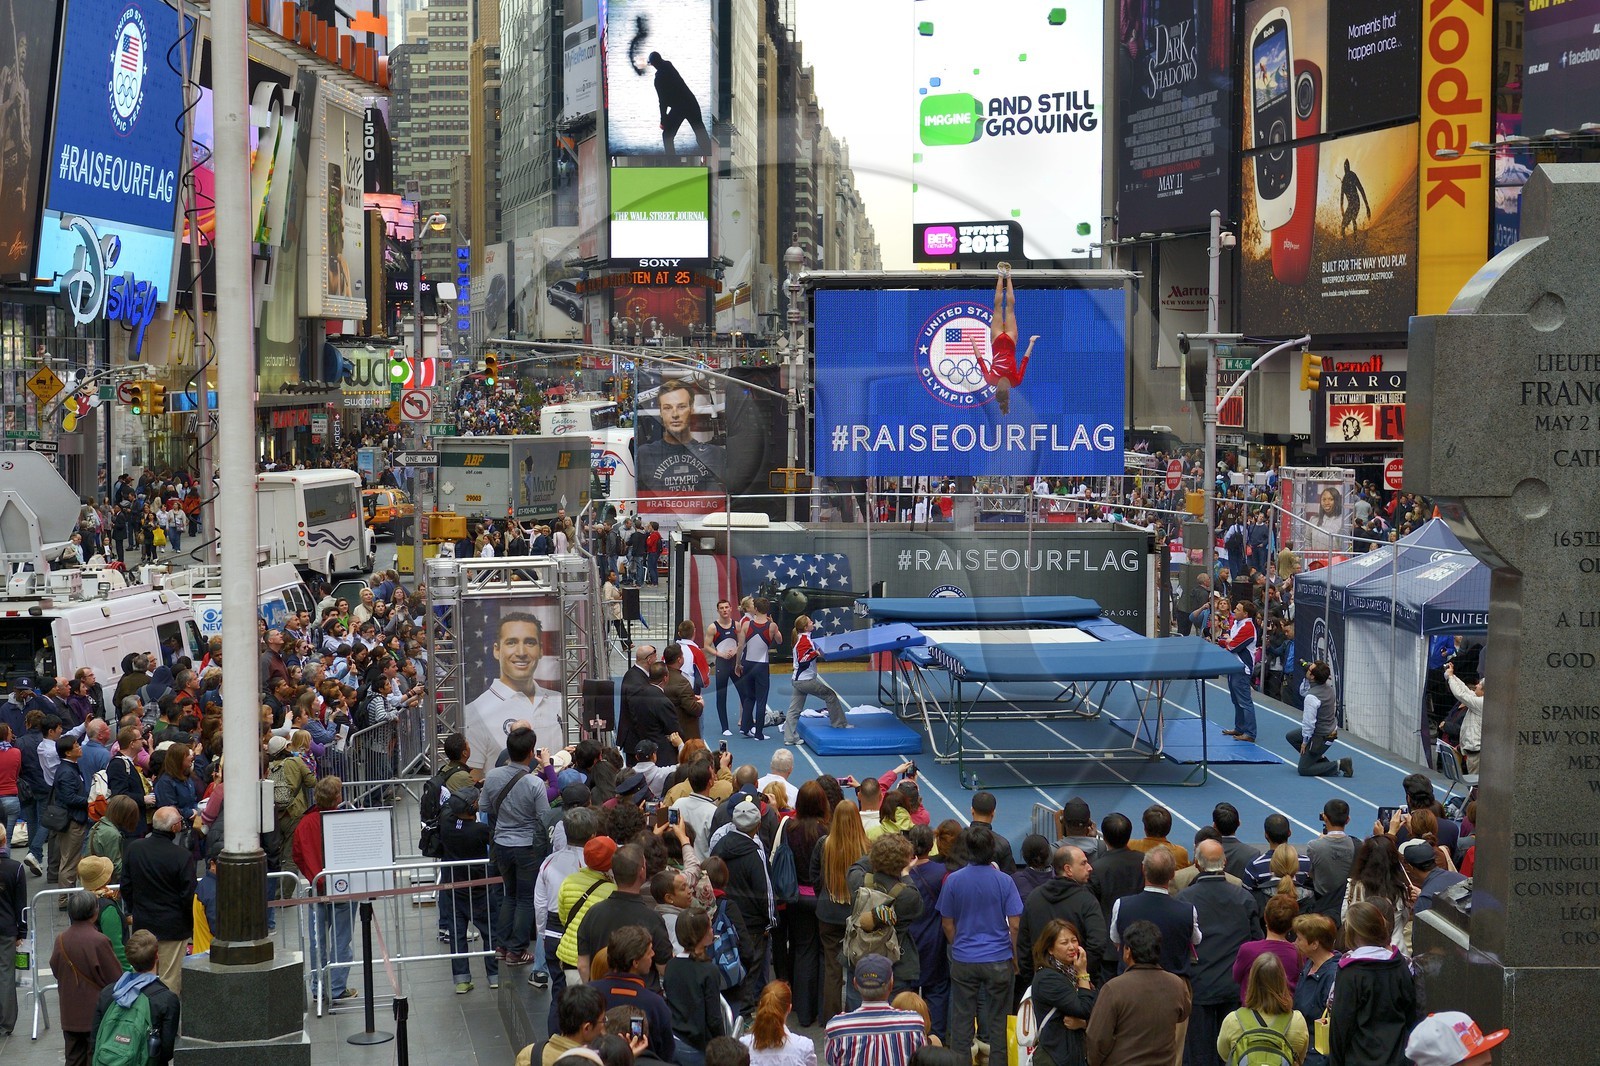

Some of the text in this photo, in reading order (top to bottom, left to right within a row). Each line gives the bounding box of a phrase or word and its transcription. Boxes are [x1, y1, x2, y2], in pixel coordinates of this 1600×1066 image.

[114, 8, 148, 53] UNITED STATES
[1348, 13, 1397, 40] Moments that
[1347, 43, 1377, 61] happen
[1568, 46, 1600, 66] faceboo
[108, 81, 144, 132] OLYMPIC TEAM
[988, 90, 1095, 117] AND STILL
[924, 112, 971, 127] IMAGINE
[985, 112, 1098, 137] GROWING
[59, 143, 175, 203] #RAISEOURFLAG
[1158, 173, 1184, 191] MAY 11
[614, 211, 629, 221] THE
[630, 211, 649, 221] WALL
[649, 211, 675, 221] STREET
[959, 235, 1009, 253] 2012
[639, 259, 681, 267] SONY
[1322, 260, 1338, 273] BUILT
[1338, 259, 1350, 271] FOR
[1350, 258, 1361, 270] THE
[1362, 257, 1377, 269] WAY
[1377, 255, 1391, 268] YOU
[656, 271, 670, 284] AT
[1168, 285, 1210, 298] Marrio
[924, 305, 963, 338] UNITED
[1227, 361, 1233, 369] W
[1234, 360, 1243, 369] 46
[921, 367, 974, 405] OLYMPIC
[1334, 393, 1348, 403] RICKY
[551, 416, 578, 425] Eastern
[1535, 415, 1589, 431] MAY 2
[431, 425, 438, 434] W
[438, 425, 447, 434] 46
[832, 424, 1116, 452] #RAISEOURFLAG
[404, 455, 437, 463] ONE WAY
[463, 454, 485, 466] ABF
[653, 454, 709, 479] UNITED STATES
[664, 474, 699, 485] OLYMPIC
[646, 499, 718, 508] #RAISEOURFLAG
[897, 549, 1139, 571] #RAISEOURFLAG
[1555, 612, 1570, 628] A
[1546, 652, 1596, 669] GOD
[1518, 730, 1560, 746] NEW
